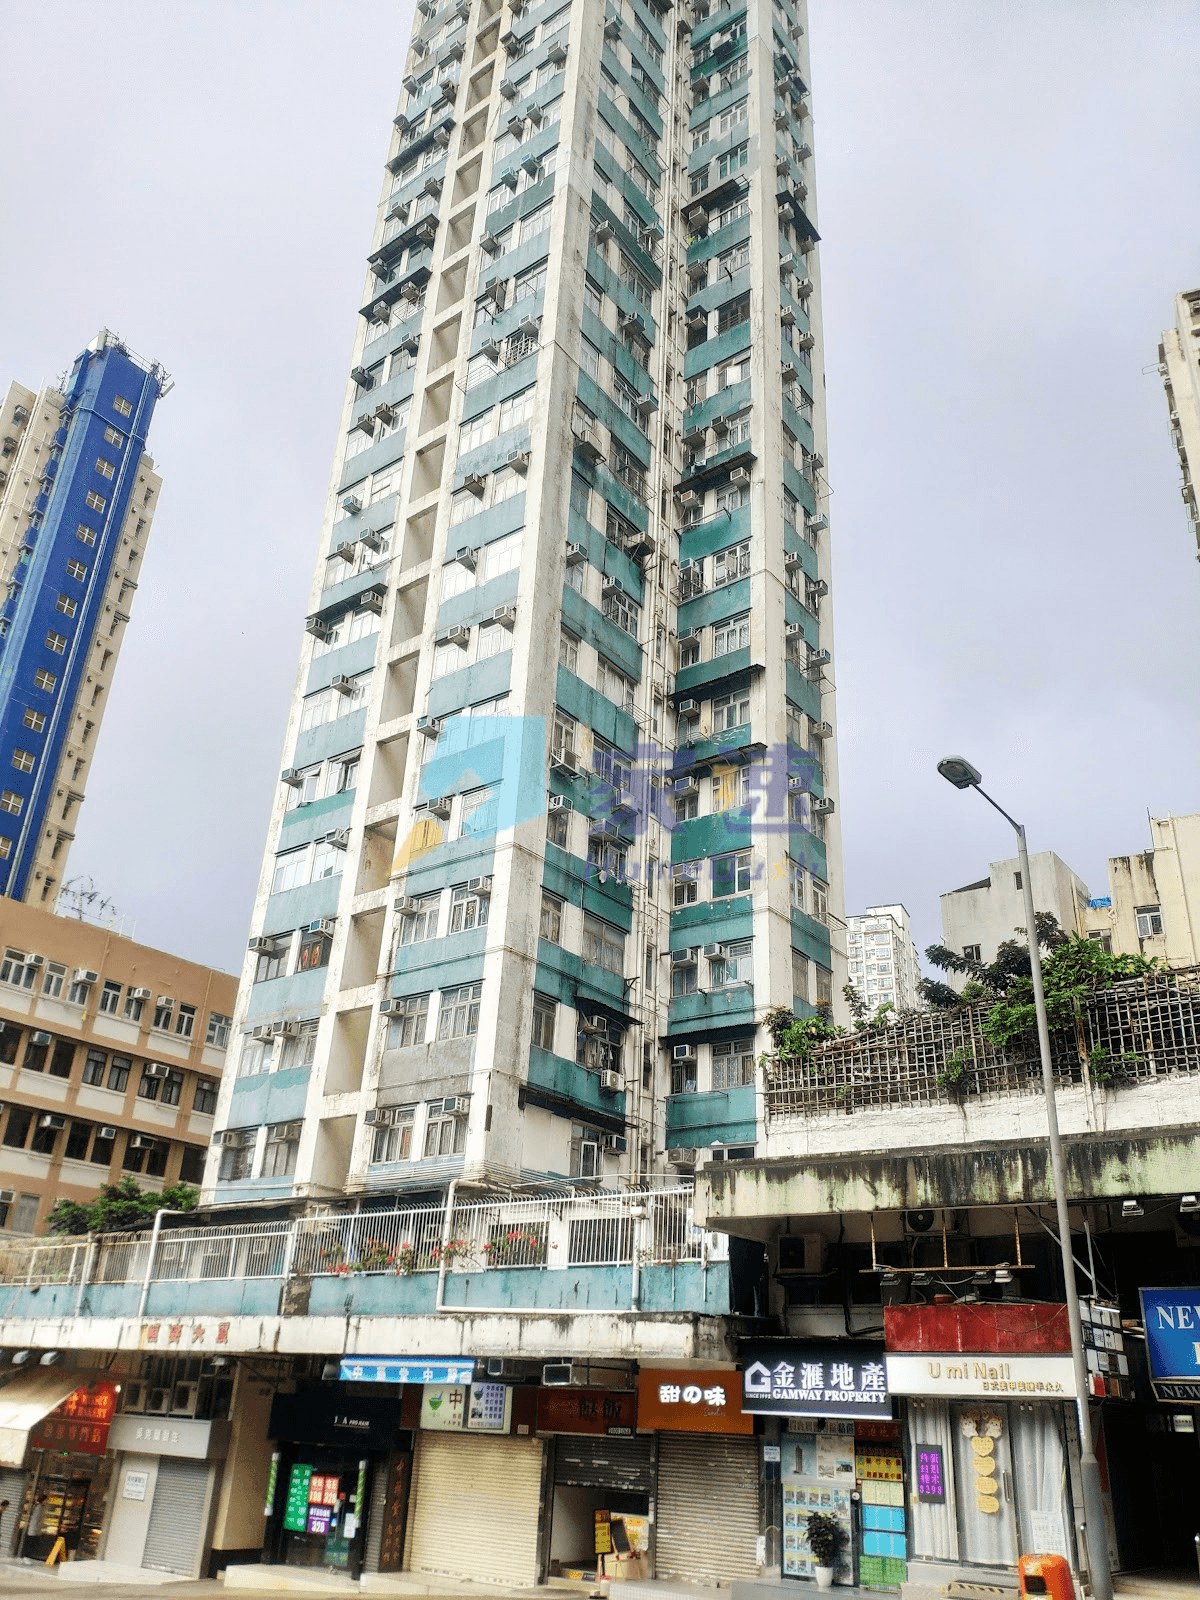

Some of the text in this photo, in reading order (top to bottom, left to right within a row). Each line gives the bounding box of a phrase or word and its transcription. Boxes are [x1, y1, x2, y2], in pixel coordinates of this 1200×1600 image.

[973, 1362, 1011, 1380] Nail
[449, 1389, 463, 1410] 中
[659, 1384, 727, 1407] 甜の味
[772, 1389, 886, 1403] GAMWAY PROPERTY
